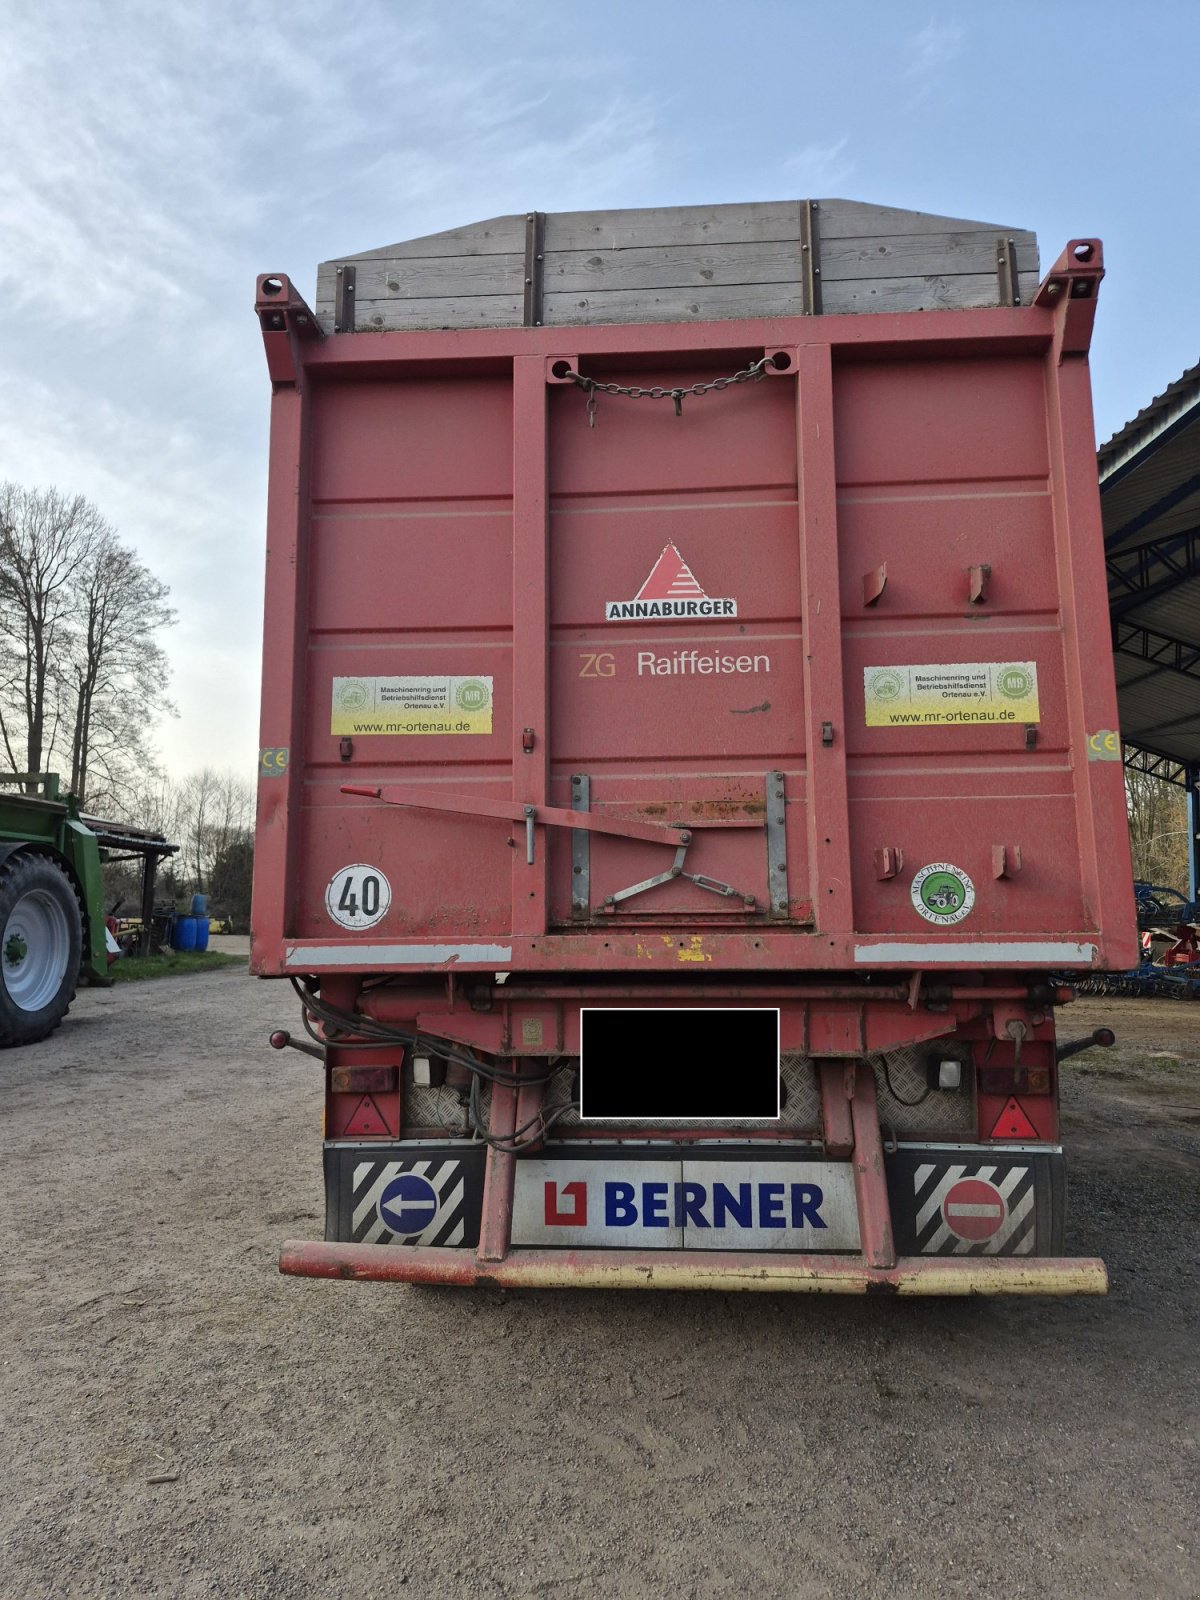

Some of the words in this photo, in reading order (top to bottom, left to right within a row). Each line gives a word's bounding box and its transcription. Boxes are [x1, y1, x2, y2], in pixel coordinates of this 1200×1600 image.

[609, 601, 734, 618] ANNABURGER
[578, 653, 616, 677] ZG
[637, 650, 770, 676] Raiffeisen
[915, 675, 970, 683] Maschinenring
[1007, 678, 1023, 689] MR
[465, 690, 480, 700] MR
[889, 710, 1016, 723] www.mr-ortenau.de
[353, 721, 471, 732] www.mr-ortenau.de
[338, 875, 380, 917] 40
[604, 1182, 828, 1229] BERNER
